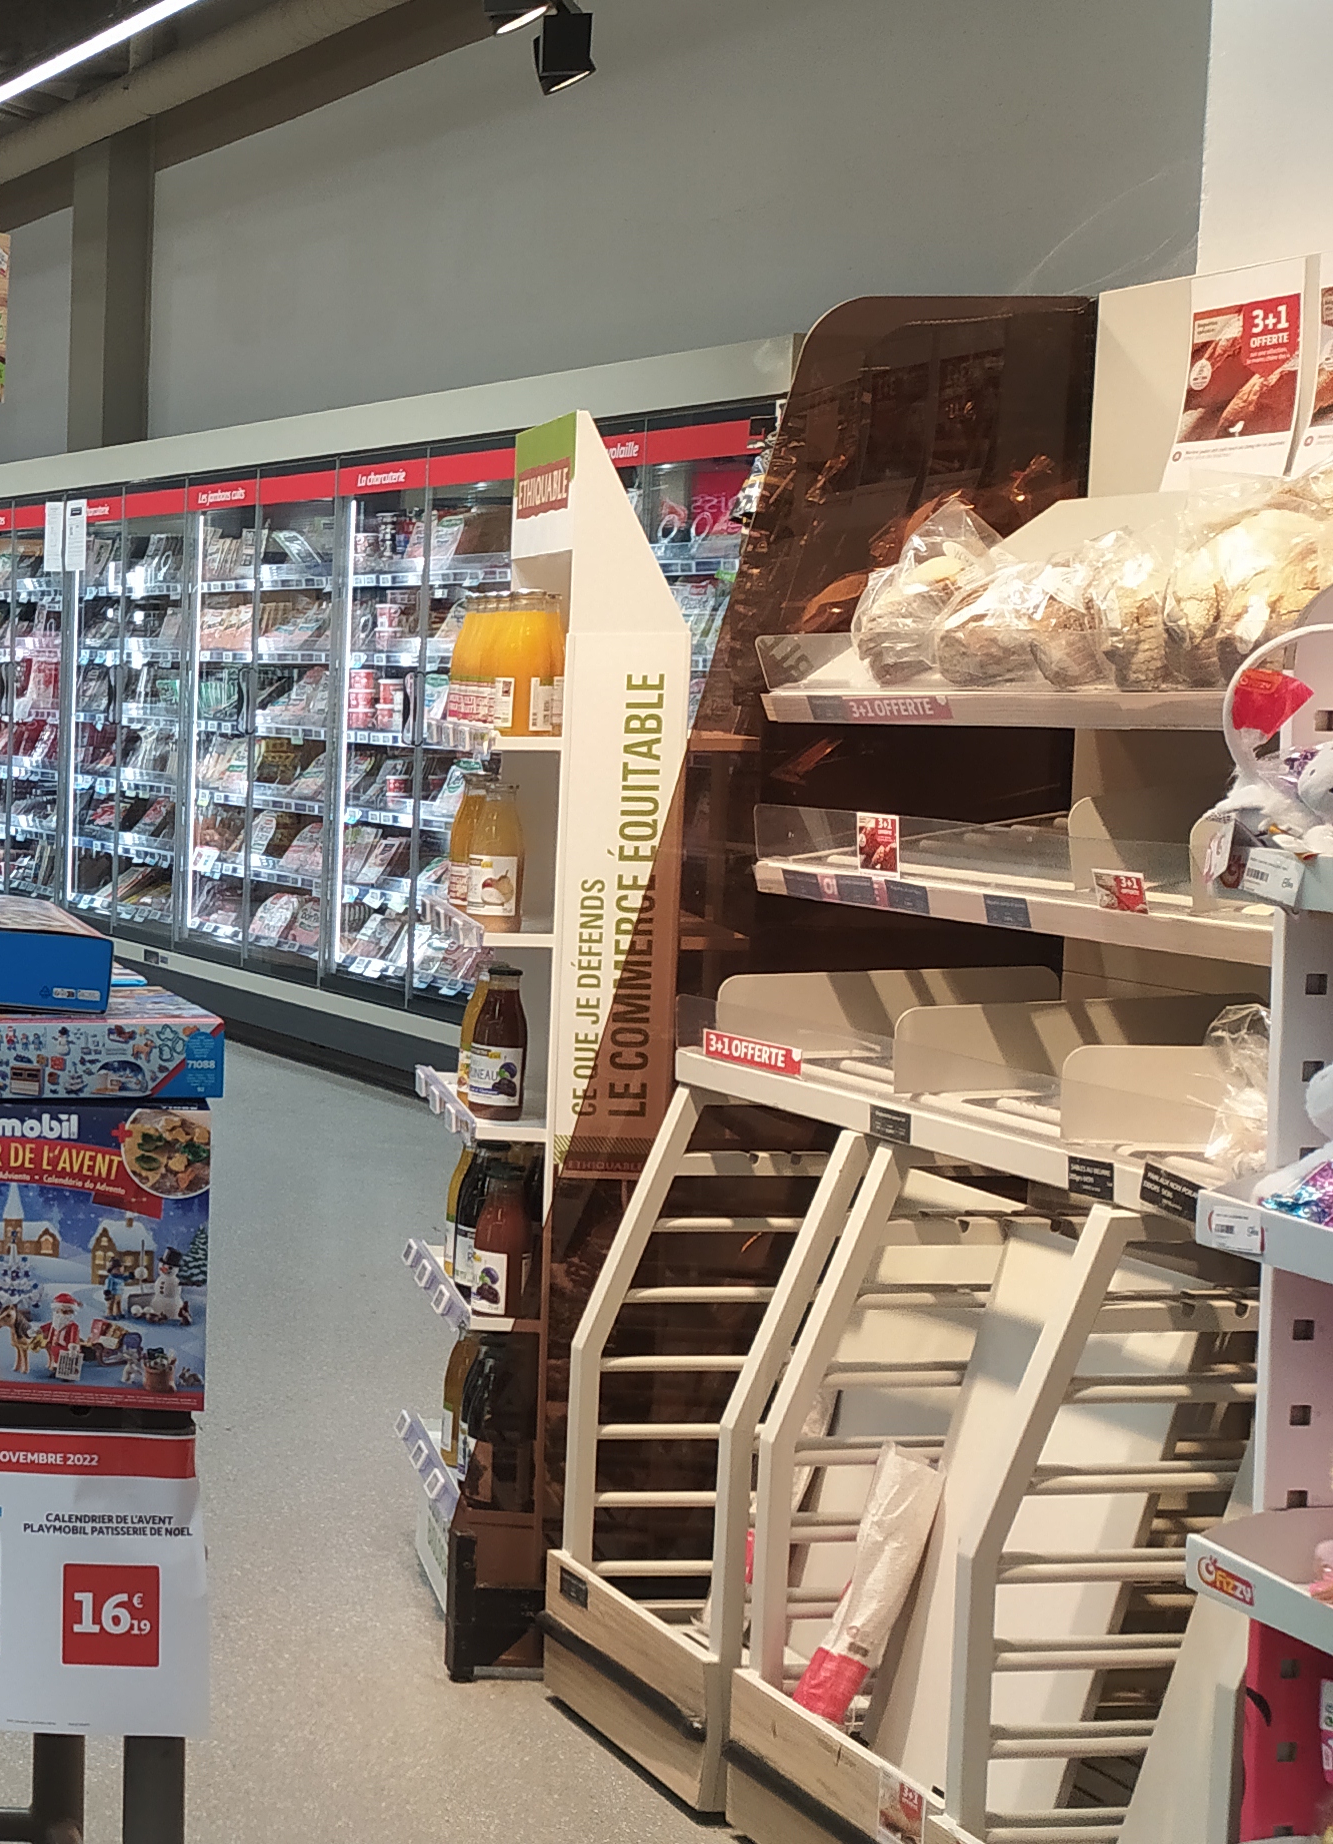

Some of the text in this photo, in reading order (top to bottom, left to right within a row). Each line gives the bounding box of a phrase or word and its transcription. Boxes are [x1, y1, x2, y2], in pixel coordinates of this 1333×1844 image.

[1251, 304, 1290, 334] 3+1
[1249, 331, 1290, 349] OFFERTE
[357, 470, 407, 487] La charcuterie
[517, 467, 569, 510] ETHIQUABLE
[848, 699, 934, 718] 3+1 OFFERTE
[877, 817, 892, 828] 3+1
[1119, 876, 1139, 889] 3+1
[607, 672, 665, 1118] LE COMMERCE ÉQUITABLE
[571, 878, 606, 1118] CE QUE JE DÉFENDS
[708, 1033, 786, 1069] 3+1 OFFERTE
[186, 1058, 216, 1070] 71088
[10, 1142, 35, 1169] DE
[42, 1145, 123, 1180] L'AVENT
[65, 1453, 99, 1466] 2022
[45, 1512, 174, 1526] CALENDRIER DE L'AVENT
[23, 1523, 193, 1537] PLAYMOBIL PATISSERIE DE NOEL
[72, 1592, 151, 1635] 16 € 19
